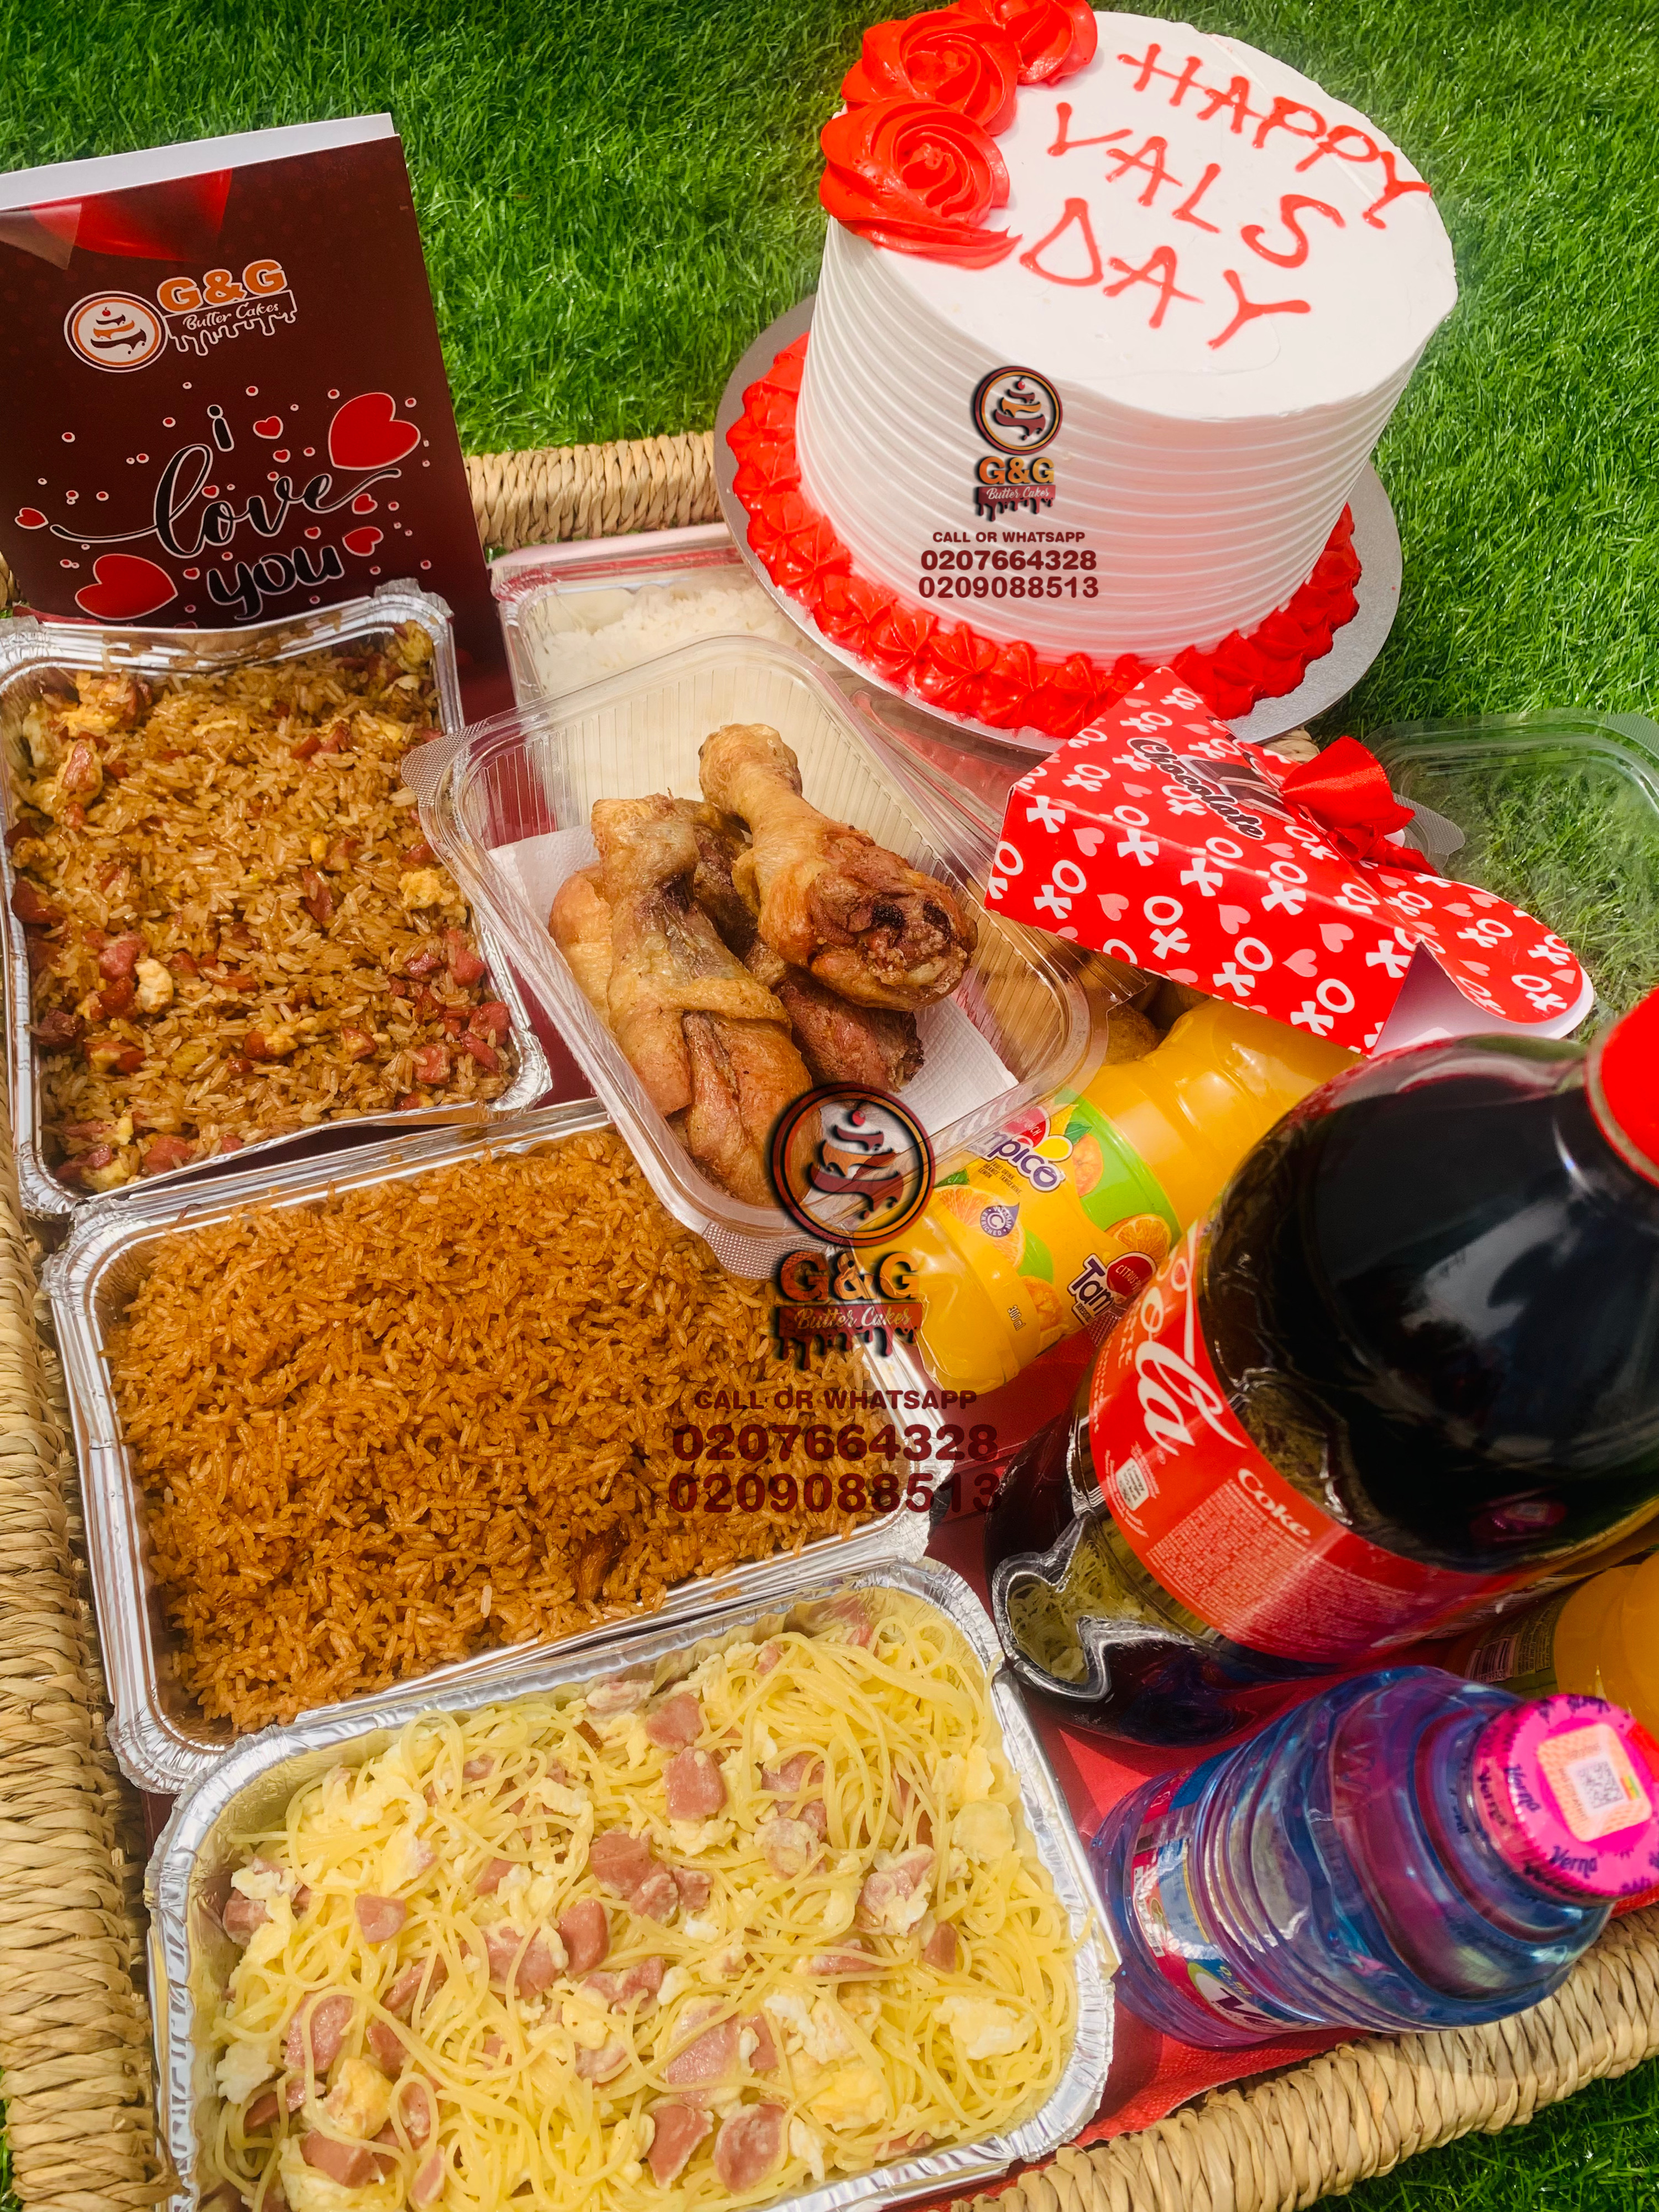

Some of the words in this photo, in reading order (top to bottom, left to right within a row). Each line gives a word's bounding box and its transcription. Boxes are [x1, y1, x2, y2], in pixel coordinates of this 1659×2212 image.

[1117, 43, 1432, 228] HAPPY
[1046, 102, 1346, 268] VALS
[157, 259, 288, 314] G&G
[1019, 197, 1312, 350] DAY
[182, 312, 232, 331] Butter
[236, 302, 279, 319] Cakes
[207, 404, 234, 452] i
[50, 443, 403, 559] love
[206, 546, 345, 621] you
[1126, 737, 1266, 841] Chocolate
[978, 1167, 993, 1179] LEMON
[990, 1161, 1004, 1171] FRUIT
[1001, 1168, 1016, 1181] DRINK
[980, 1212, 1002, 1236] ENRICHED
[993, 1206, 1012, 1229] VITAMIN
[1115, 1265, 1139, 1286] CITRUS
[1237, 1468, 1311, 1537] Coke
[1507, 1764, 1541, 1813] Verna
[1550, 1845, 1598, 1879] Verna
